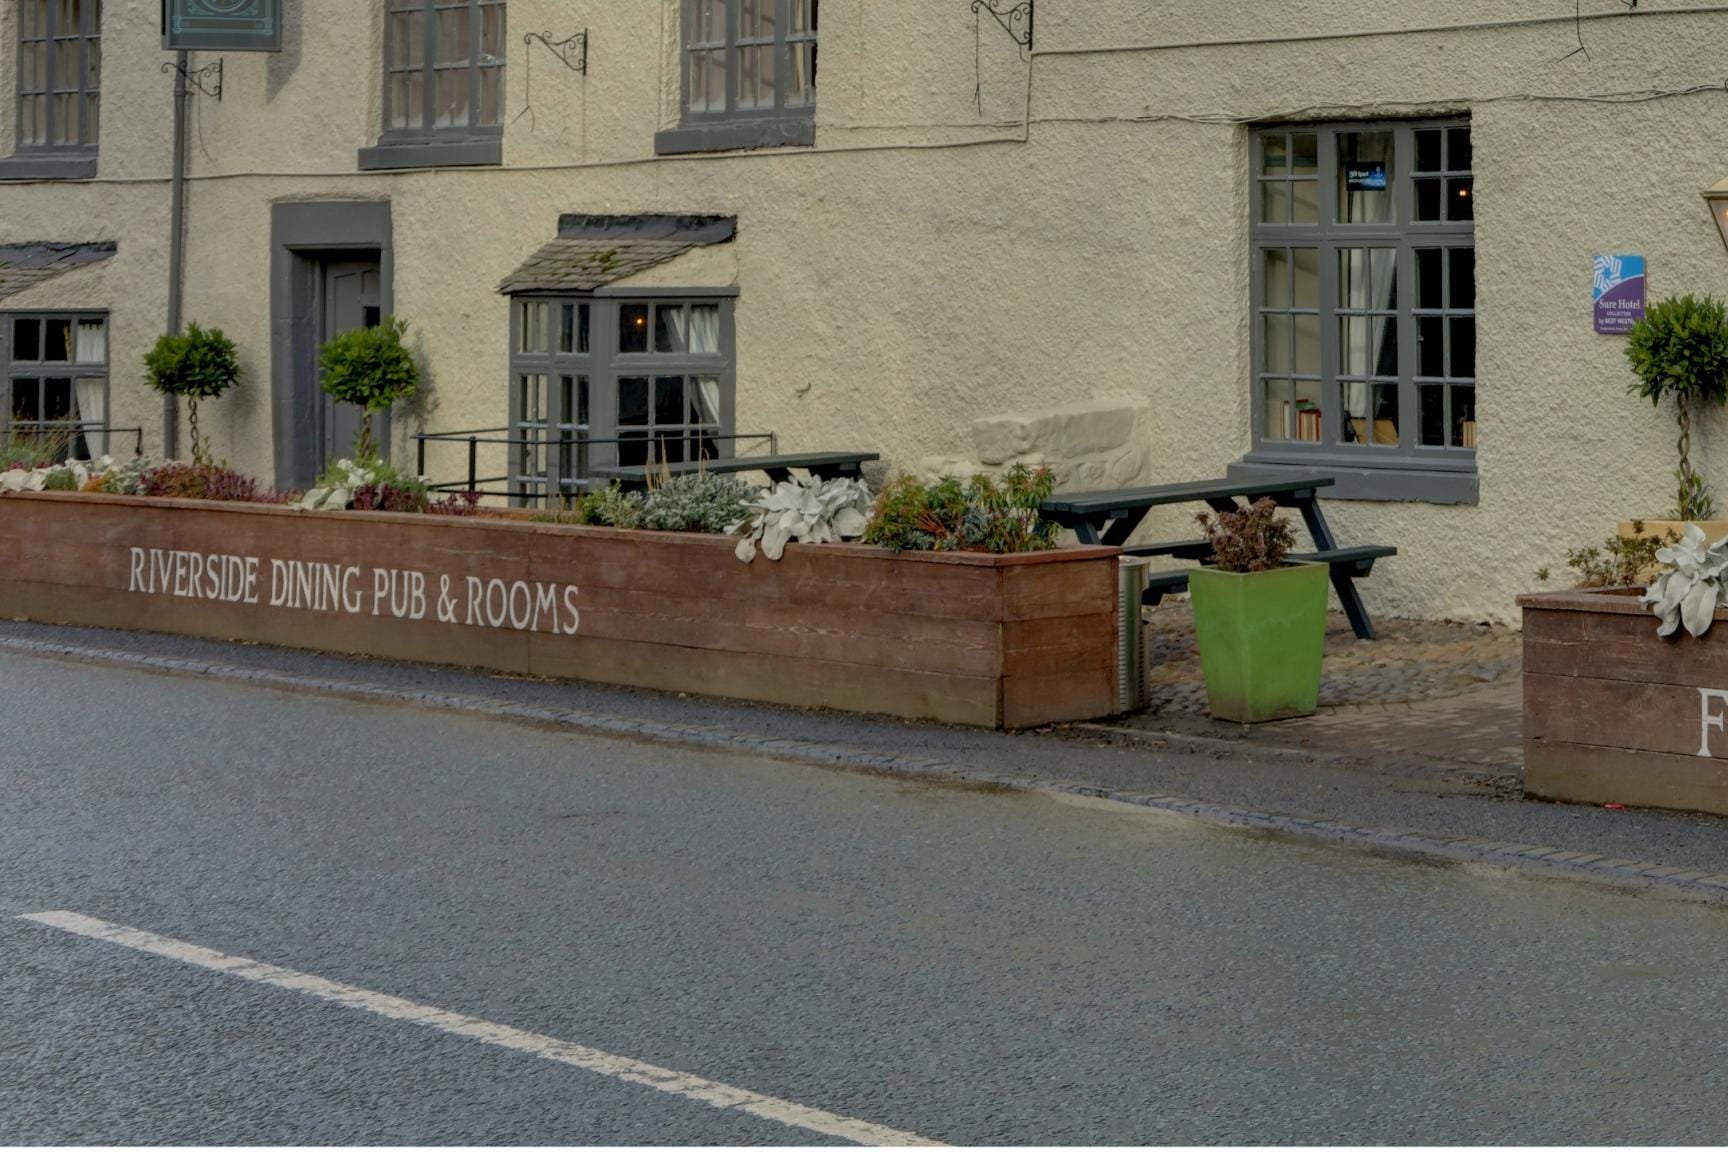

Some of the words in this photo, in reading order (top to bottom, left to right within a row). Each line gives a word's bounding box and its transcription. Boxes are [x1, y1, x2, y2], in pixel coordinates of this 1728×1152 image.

[1599, 298, 1617, 309] Sure
[1618, 299, 1640, 309] Hotel
[129, 547, 259, 604] RIVERSIDE
[270, 558, 362, 614] DINING
[372, 568, 427, 620] PUB
[437, 573, 458, 624] &
[465, 575, 580, 635] ROOMS
